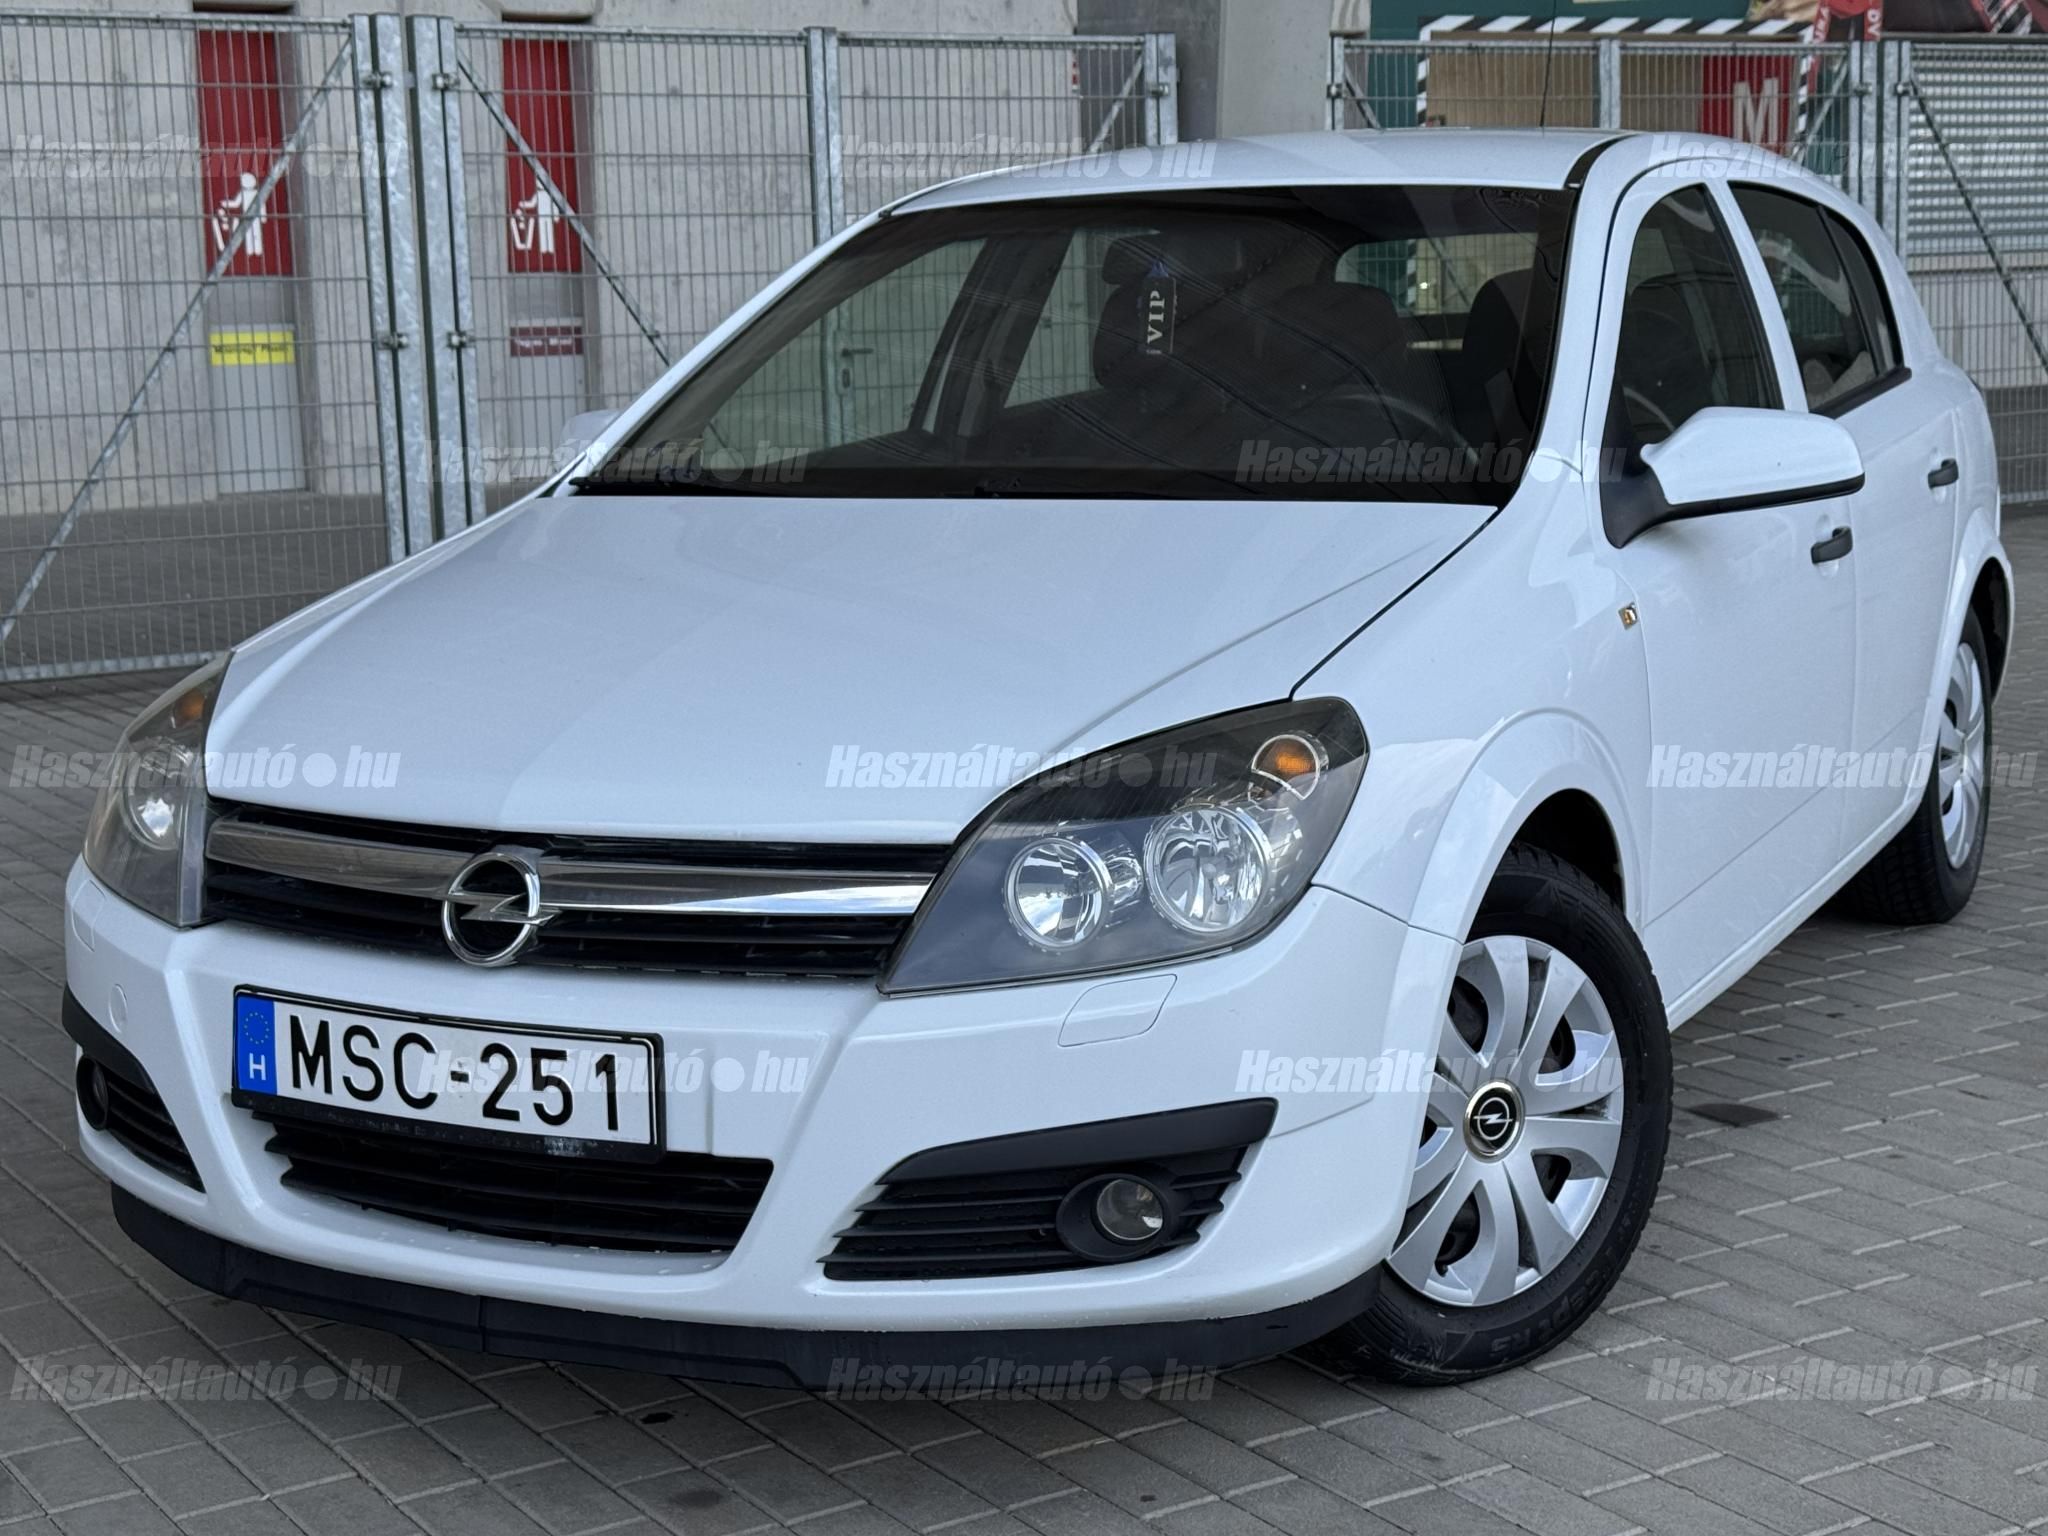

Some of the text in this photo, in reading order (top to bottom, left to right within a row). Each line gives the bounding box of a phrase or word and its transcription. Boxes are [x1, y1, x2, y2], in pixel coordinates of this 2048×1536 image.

[1146, 290, 1165, 344] VIP
[248, 1052, 266, 1081] H
[289, 1014, 620, 1131] MSC-251
